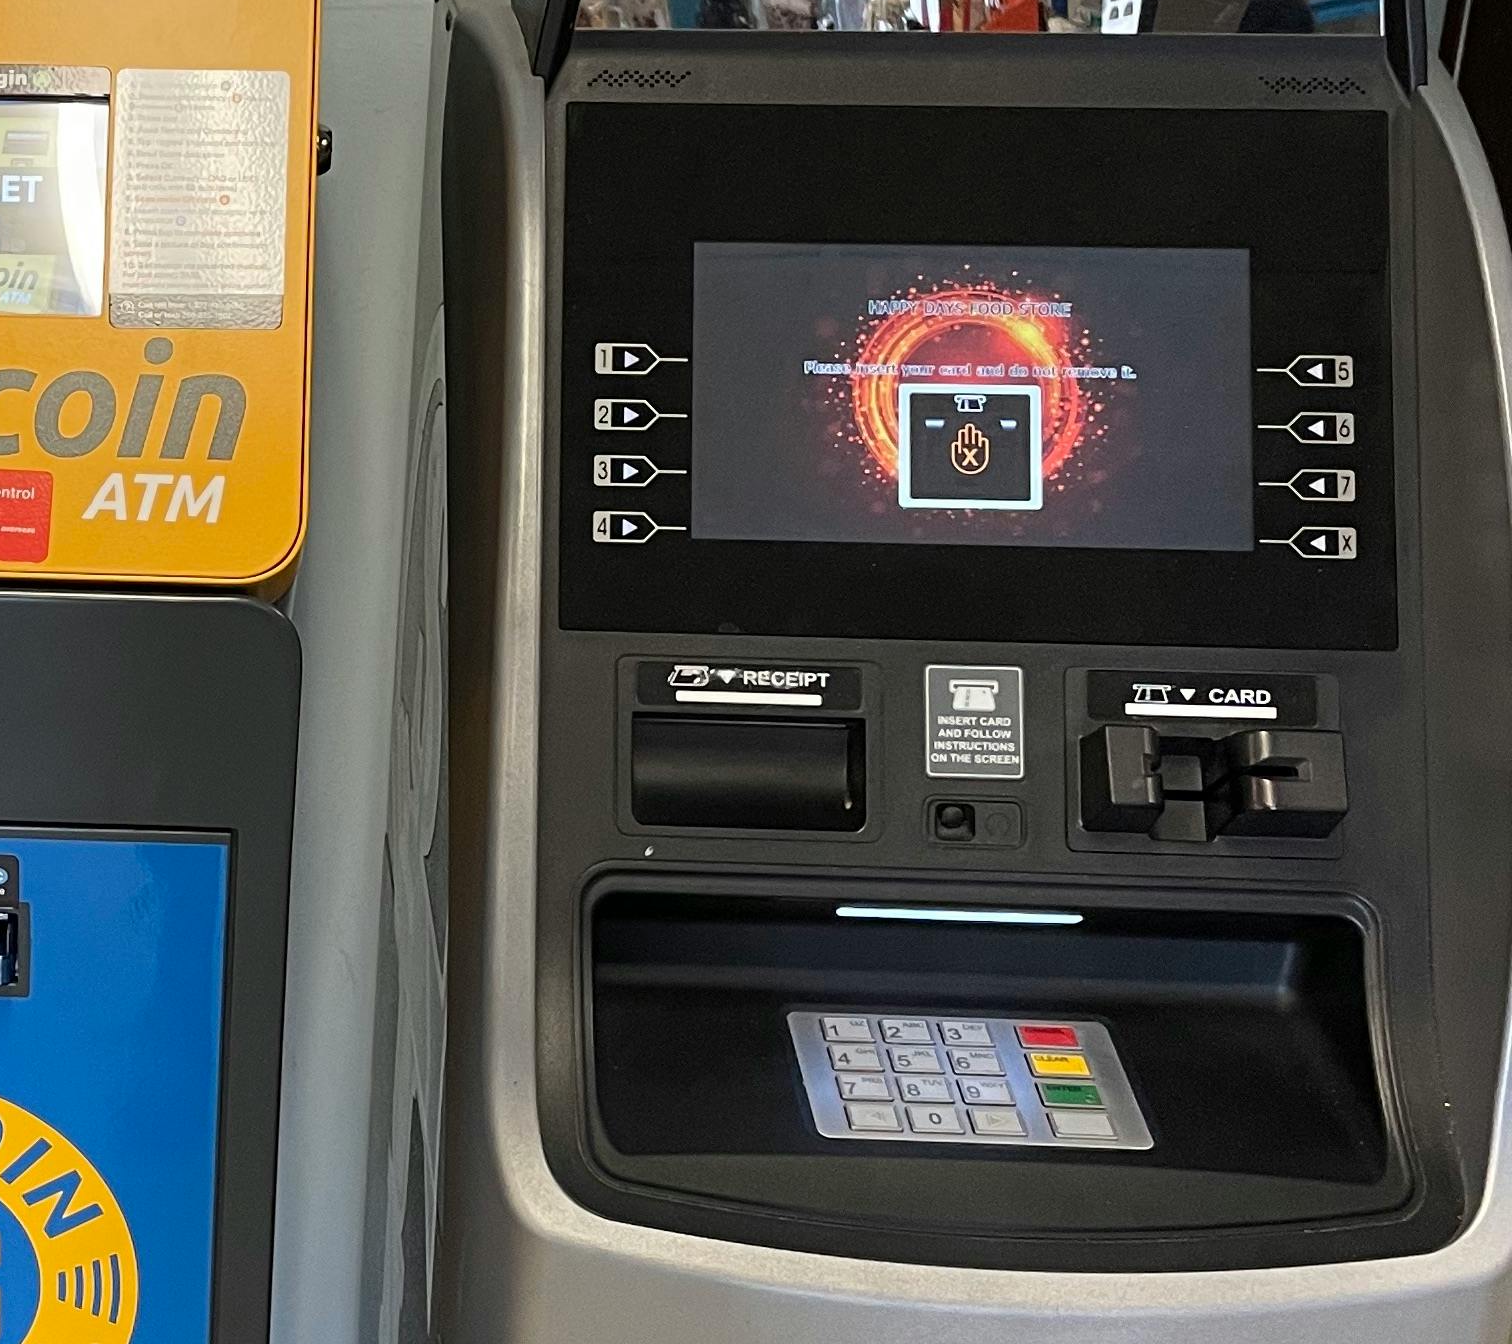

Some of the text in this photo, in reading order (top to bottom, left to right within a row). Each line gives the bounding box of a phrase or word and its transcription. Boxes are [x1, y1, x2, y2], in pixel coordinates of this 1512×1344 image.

[868, 301, 918, 316] HAPPY
[924, 301, 964, 316] DAYS
[1018, 302, 1072, 317] STORE
[601, 350, 607, 368] 1
[804, 361, 851, 375] Please
[855, 362, 897, 375] insert
[902, 365, 935, 377] your
[940, 363, 970, 376] card
[976, 363, 1003, 376] and
[1008, 363, 1028, 377] do
[1032, 365, 1058, 378] not
[1062, 367, 1117, 378] remove
[1338, 363, 1349, 381] 5
[598, 406, 609, 424] 2
[1339, 421, 1350, 438] 6
[597, 462, 608, 480] 3
[1341, 477, 1350, 495] 7
[82, 474, 226, 523] ATM
[597, 518, 607, 536] 4
[1342, 536, 1352, 552] X
[743, 669, 829, 689] RECEIPT
[1208, 688, 1271, 704] CARD
[937, 716, 1011, 726] INSERT CARD
[938, 729, 1011, 738] AND FOLLOW
[933, 741, 1015, 751] INSTRUCTIONS
[930, 753, 1019, 764] ON THE SCREEN
